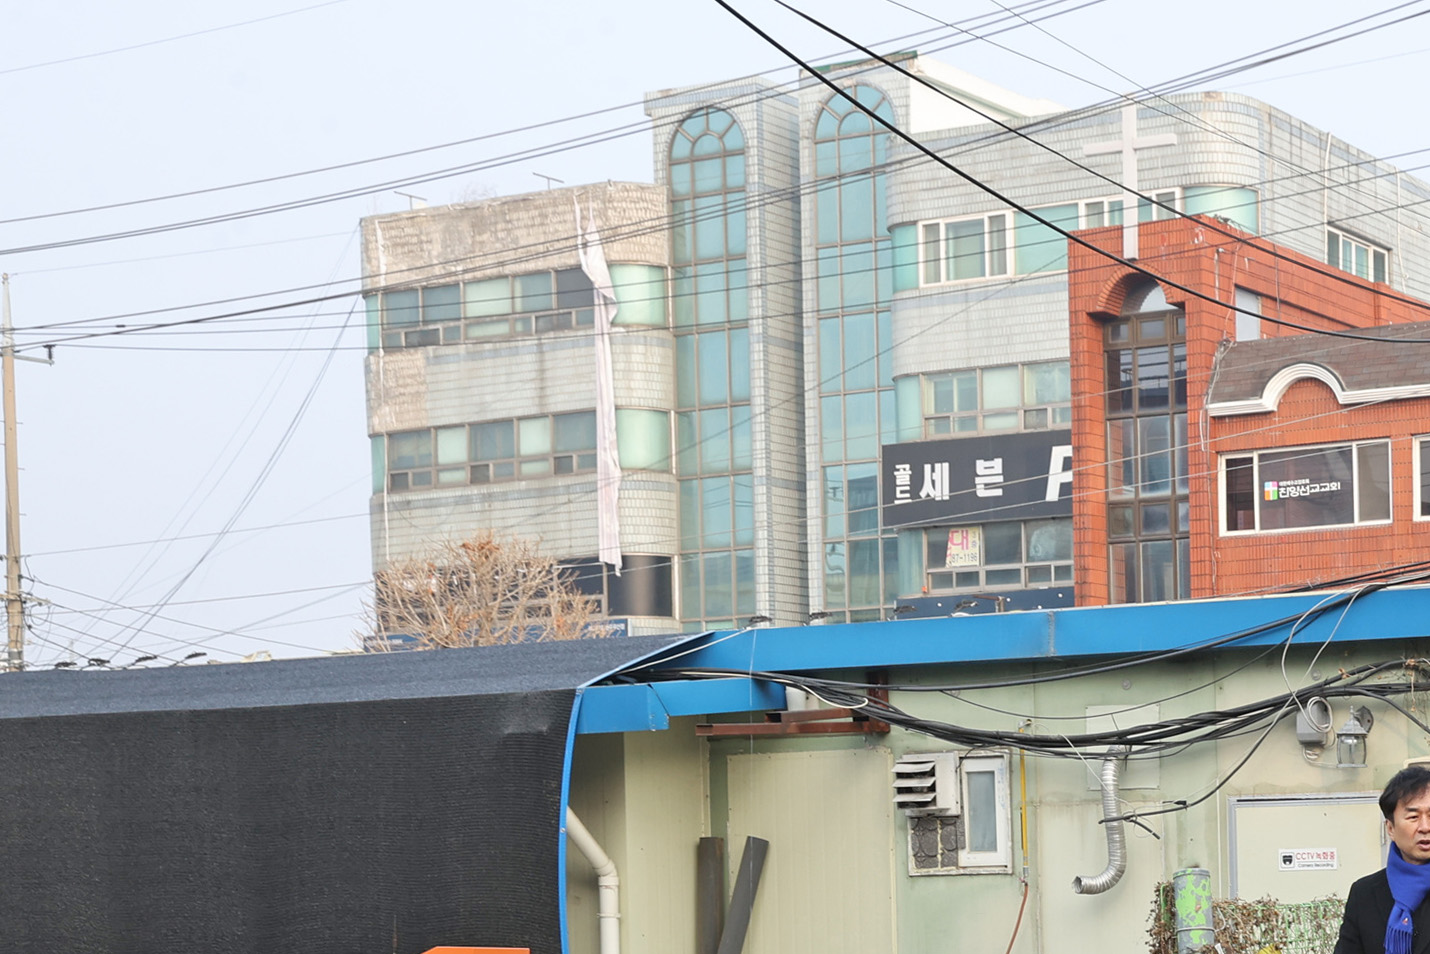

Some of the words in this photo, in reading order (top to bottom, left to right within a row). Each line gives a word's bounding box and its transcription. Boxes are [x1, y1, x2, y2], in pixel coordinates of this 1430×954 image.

[893, 464, 912, 504] 골드
[919, 457, 1004, 501] 세븐
[1295, 852, 1315, 860] CCTV
